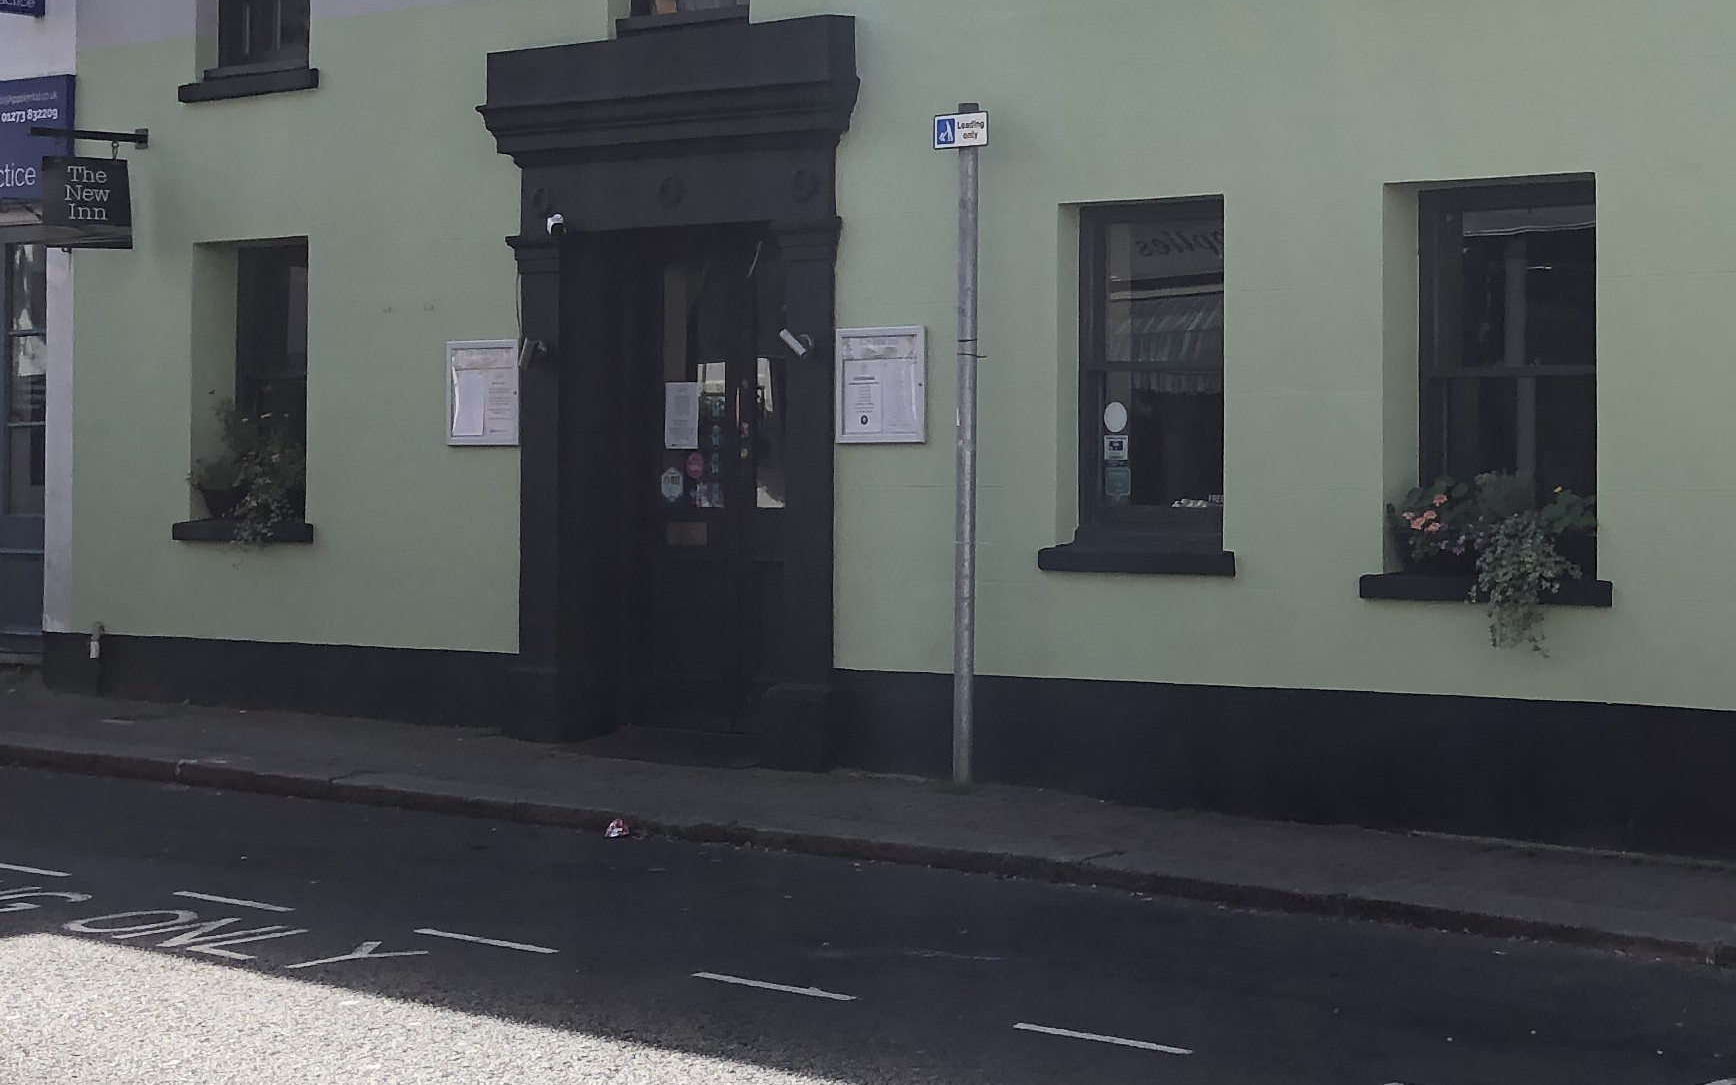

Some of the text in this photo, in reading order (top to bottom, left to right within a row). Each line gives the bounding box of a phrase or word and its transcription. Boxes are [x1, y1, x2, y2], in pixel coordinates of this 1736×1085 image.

[1, 108, 58, 123] 01273 832209
[957, 120, 985, 129] Loading
[963, 131, 979, 140] only
[67, 165, 108, 184] The
[65, 185, 111, 202] New
[68, 203, 108, 220] Inn
[62, 908, 430, 969] ONLY
